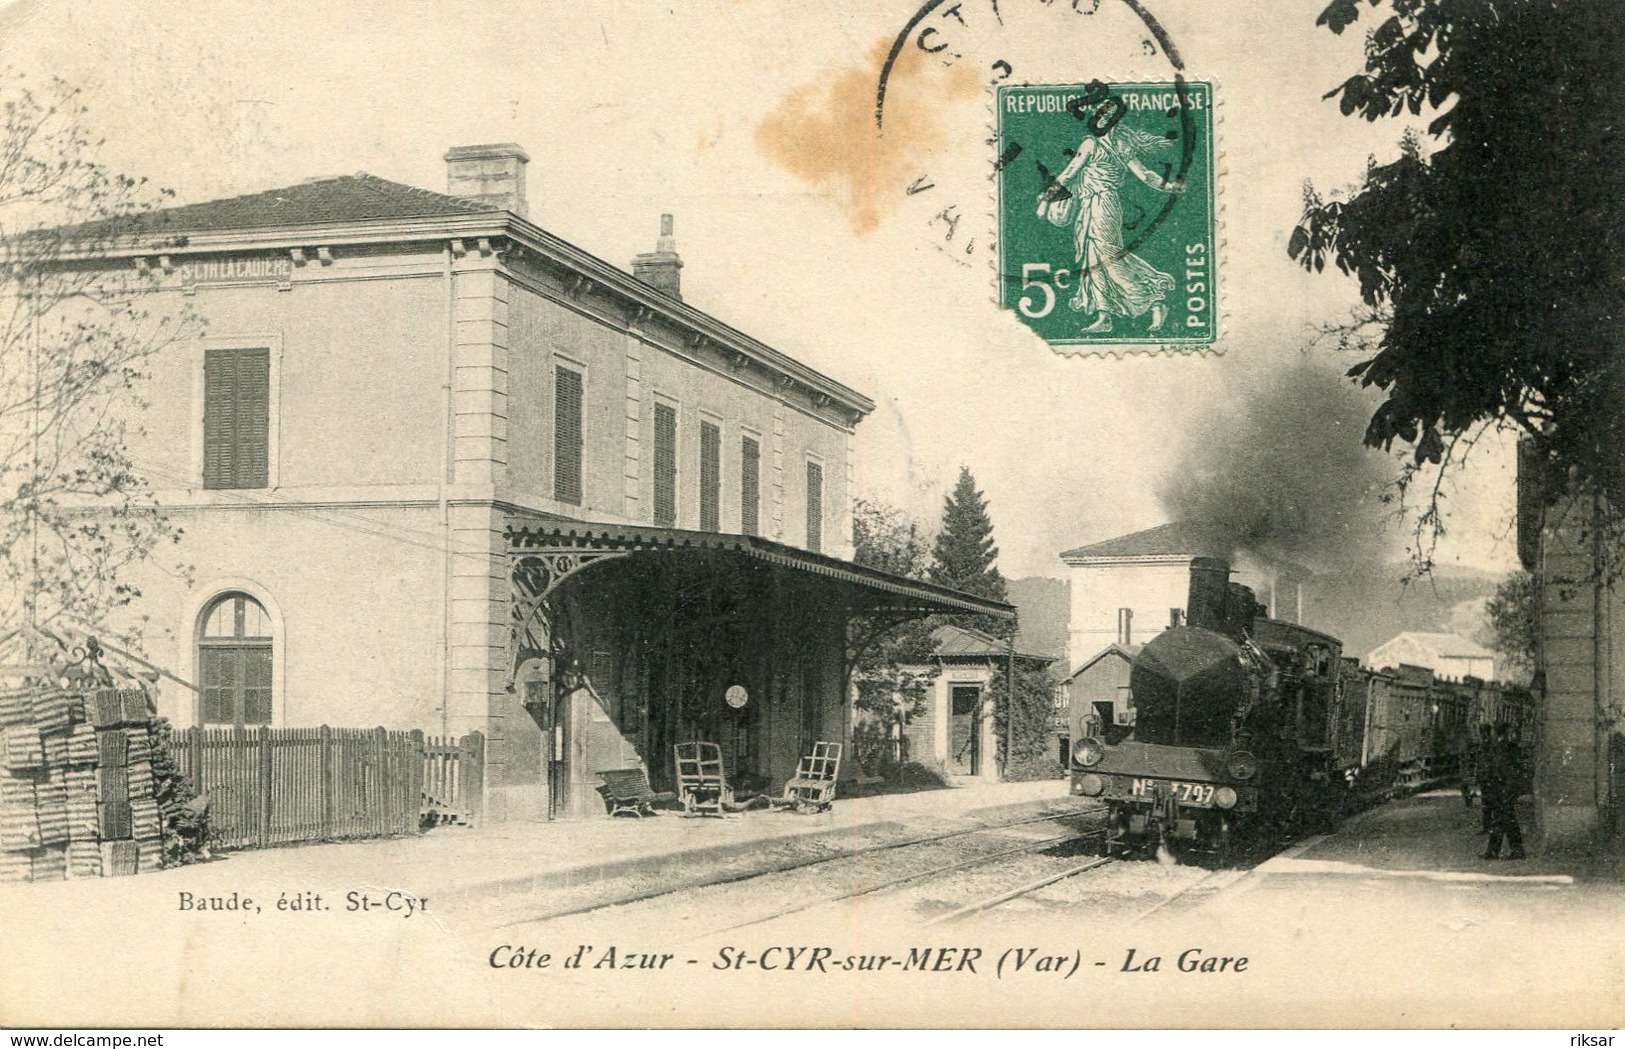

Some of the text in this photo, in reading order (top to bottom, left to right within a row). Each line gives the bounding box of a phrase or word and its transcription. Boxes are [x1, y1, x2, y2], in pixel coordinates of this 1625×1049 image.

[1006, 92, 1204, 114] REPUBLI FRANÇASE
[1186, 242, 1206, 329] POSTES
